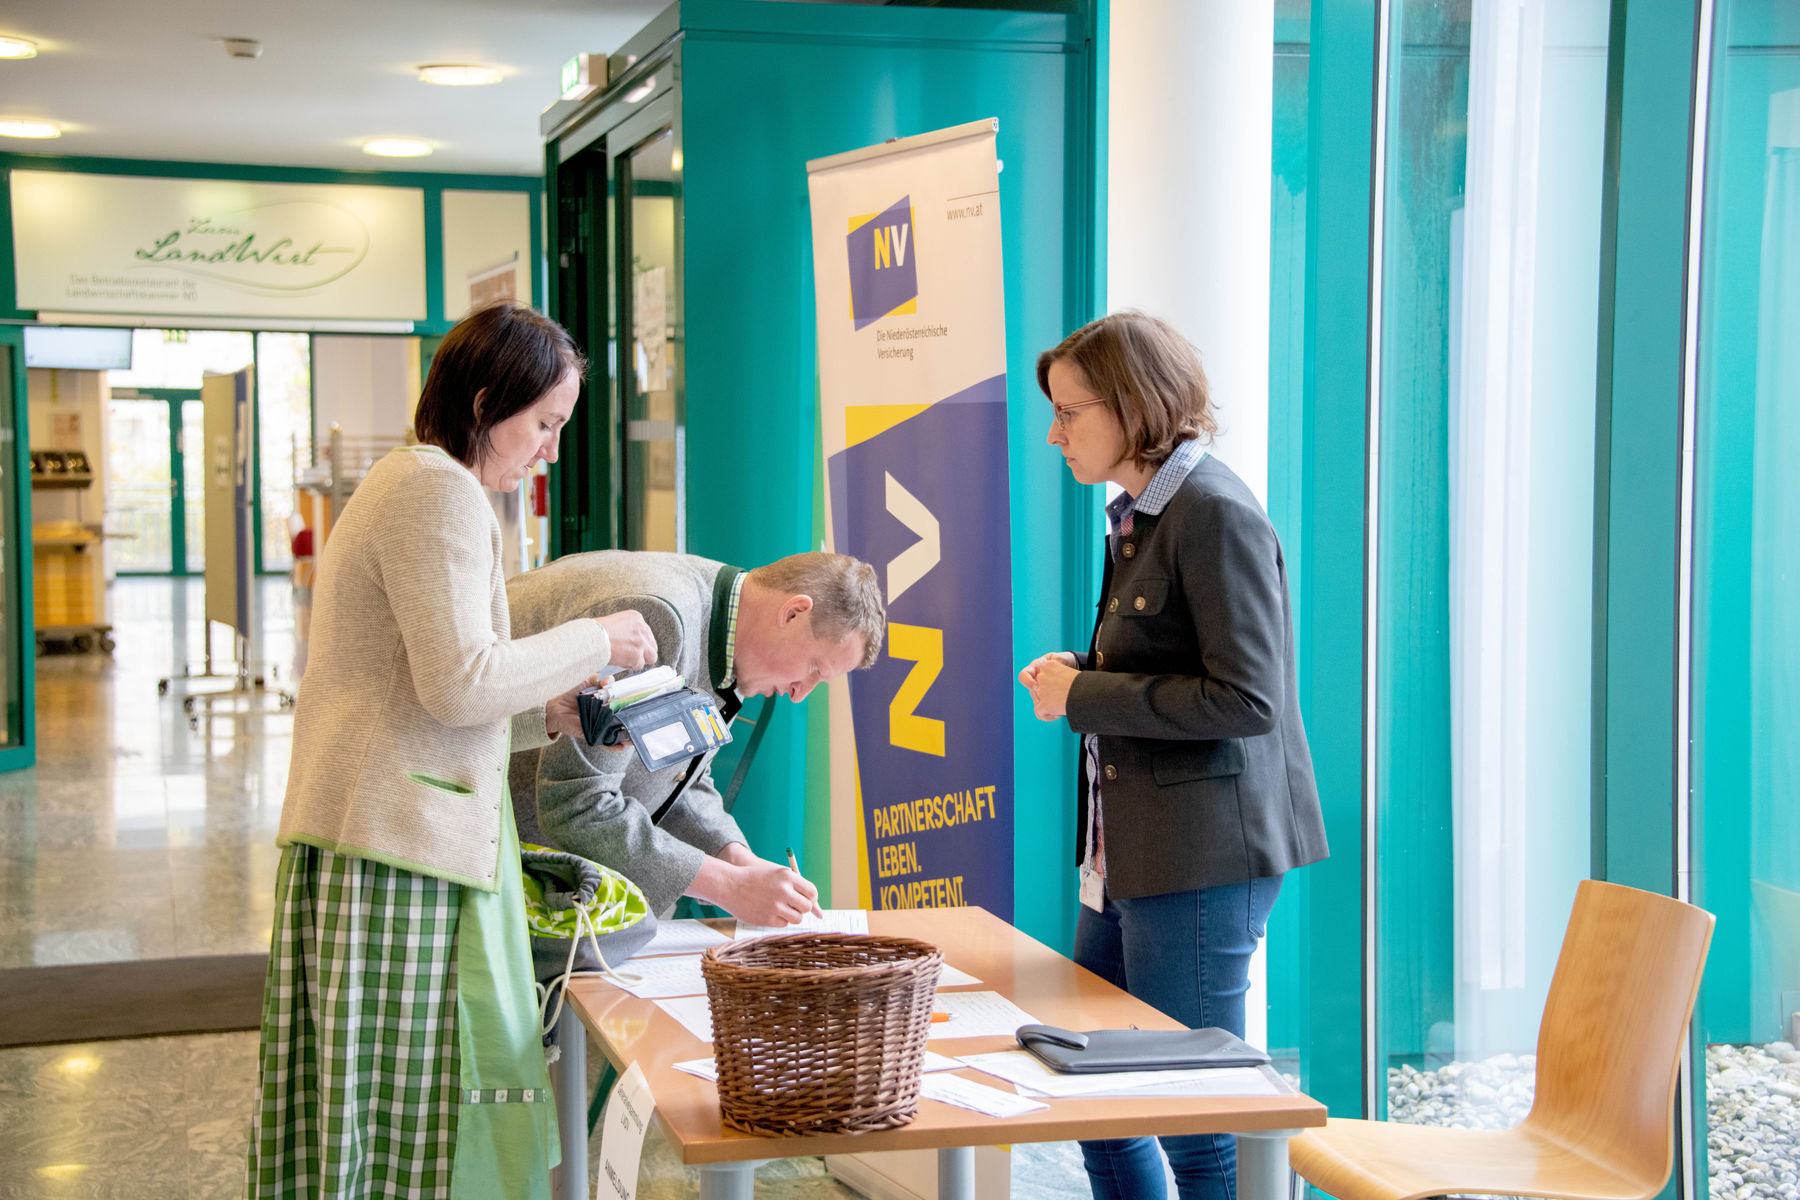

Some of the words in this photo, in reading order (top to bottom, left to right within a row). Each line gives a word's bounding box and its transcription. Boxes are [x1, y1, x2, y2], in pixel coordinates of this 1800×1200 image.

[946, 202, 983, 221] www.nv.at
[134, 231, 352, 267] LandWirt
[874, 223, 909, 270] NV
[876, 329, 886, 342] Die
[886, 324, 948, 341] Niederösterreichische
[877, 347, 914, 361] Versicherung
[884, 470, 946, 757] NV
[873, 785, 996, 839] PARTNERSCHAFT
[877, 841, 922, 878] LEBEN.
